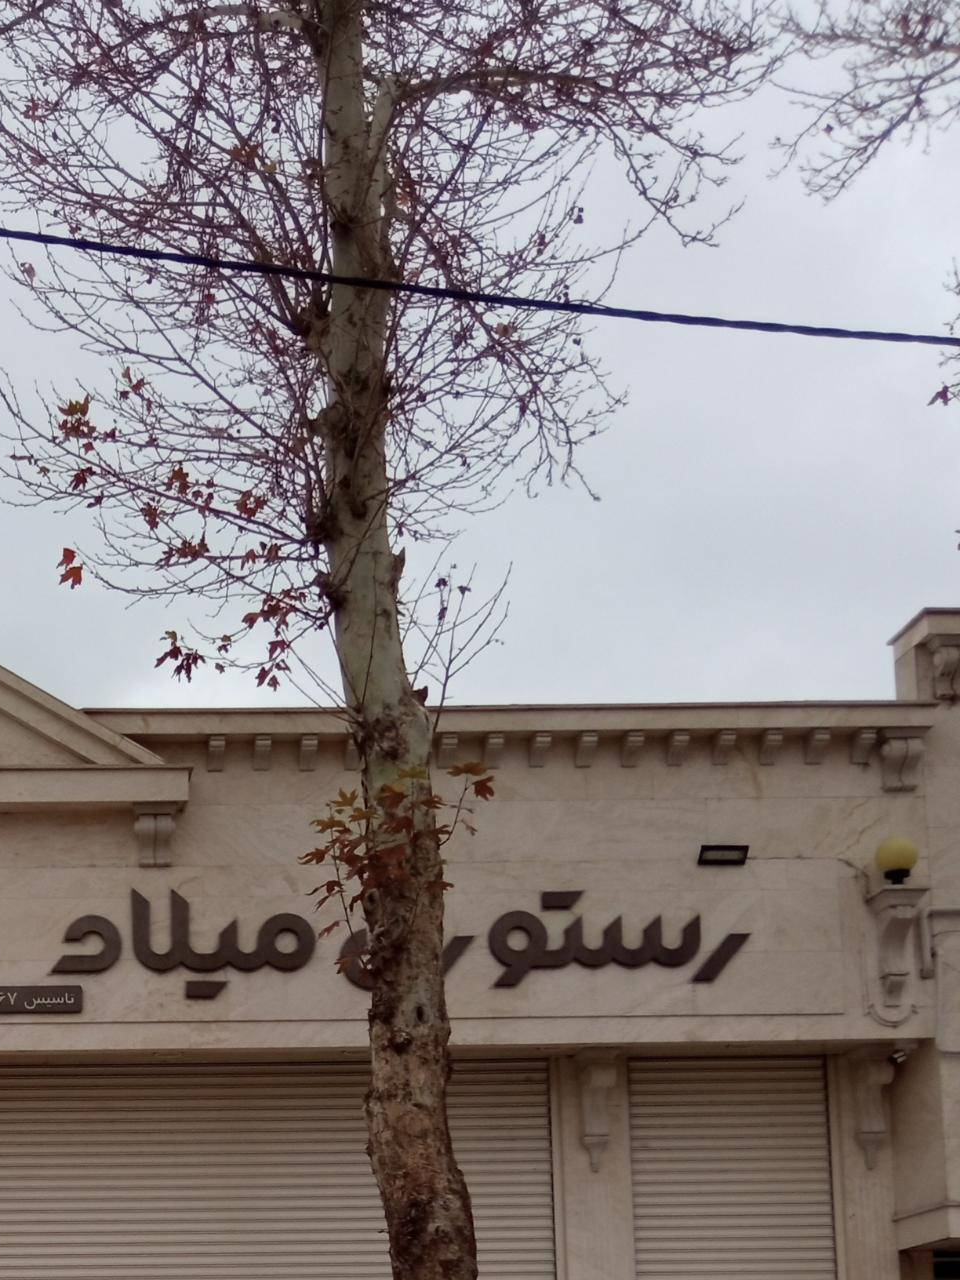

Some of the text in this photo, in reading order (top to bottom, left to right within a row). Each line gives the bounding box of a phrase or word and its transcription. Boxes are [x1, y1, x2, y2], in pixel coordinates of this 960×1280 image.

[49, 886, 753, 1001] رستور میلاد
[24, 992, 75, 1010] تاسیس
